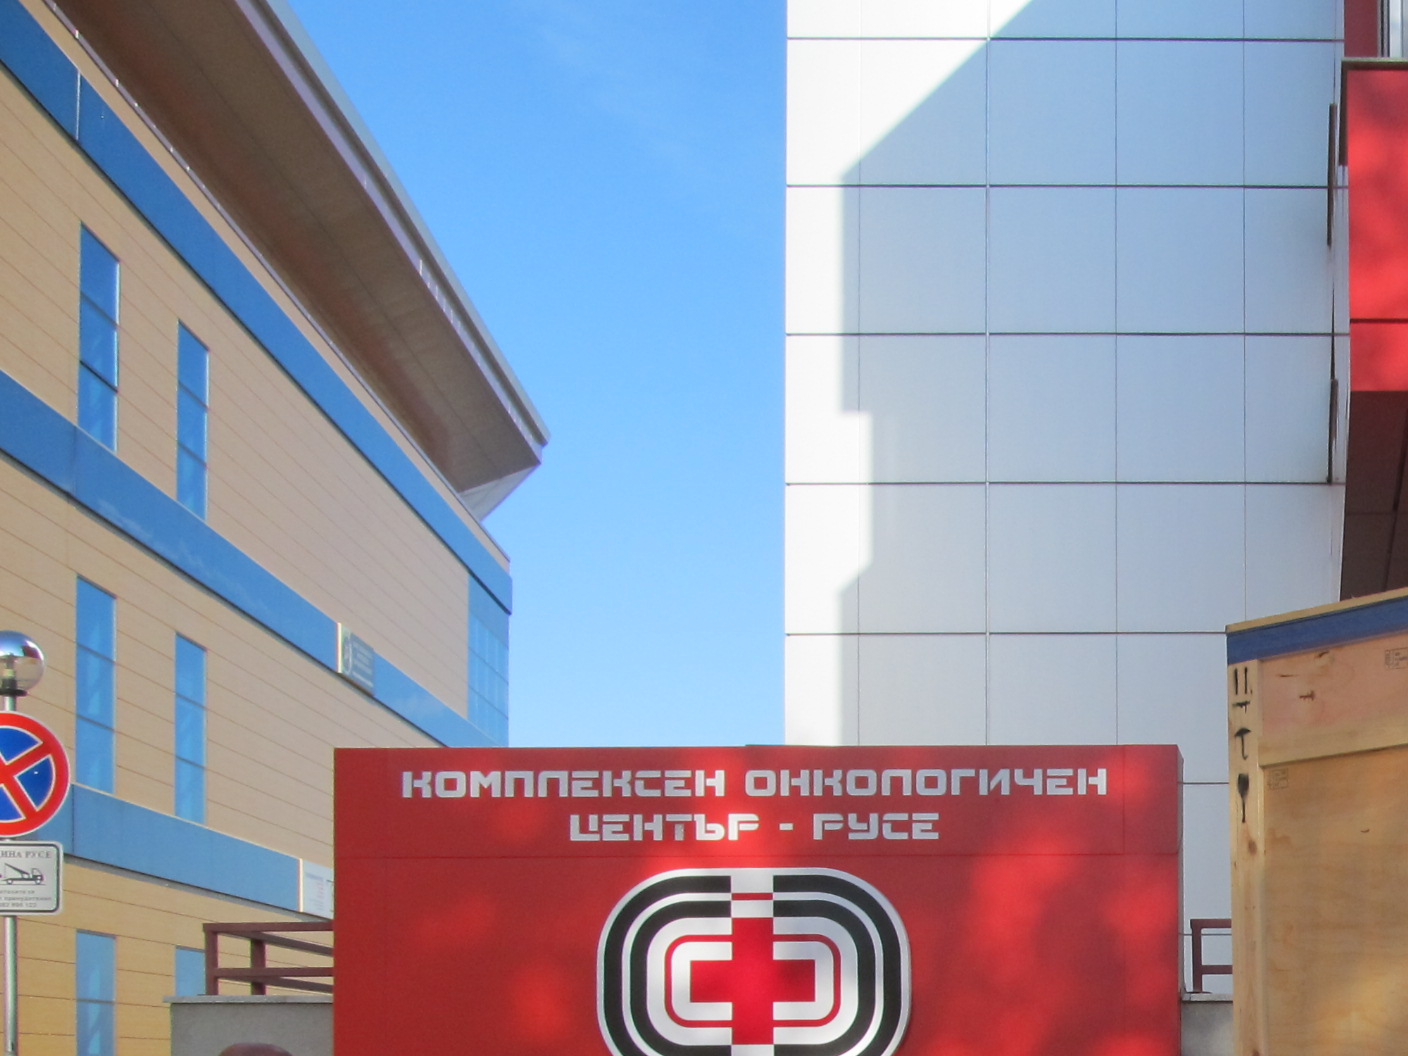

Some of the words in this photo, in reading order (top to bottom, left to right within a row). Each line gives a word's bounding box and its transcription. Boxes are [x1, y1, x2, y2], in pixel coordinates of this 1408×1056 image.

[403, 769, 726, 799] КОМПЛЕКСЕН
[744, 767, 1107, 797] ОНКОЛОГИЧЕН
[570, 813, 760, 842] ЦЕНТЪР
[813, 813, 940, 841] РУСЕ
[25, 850, 52, 858] РУСЕ
